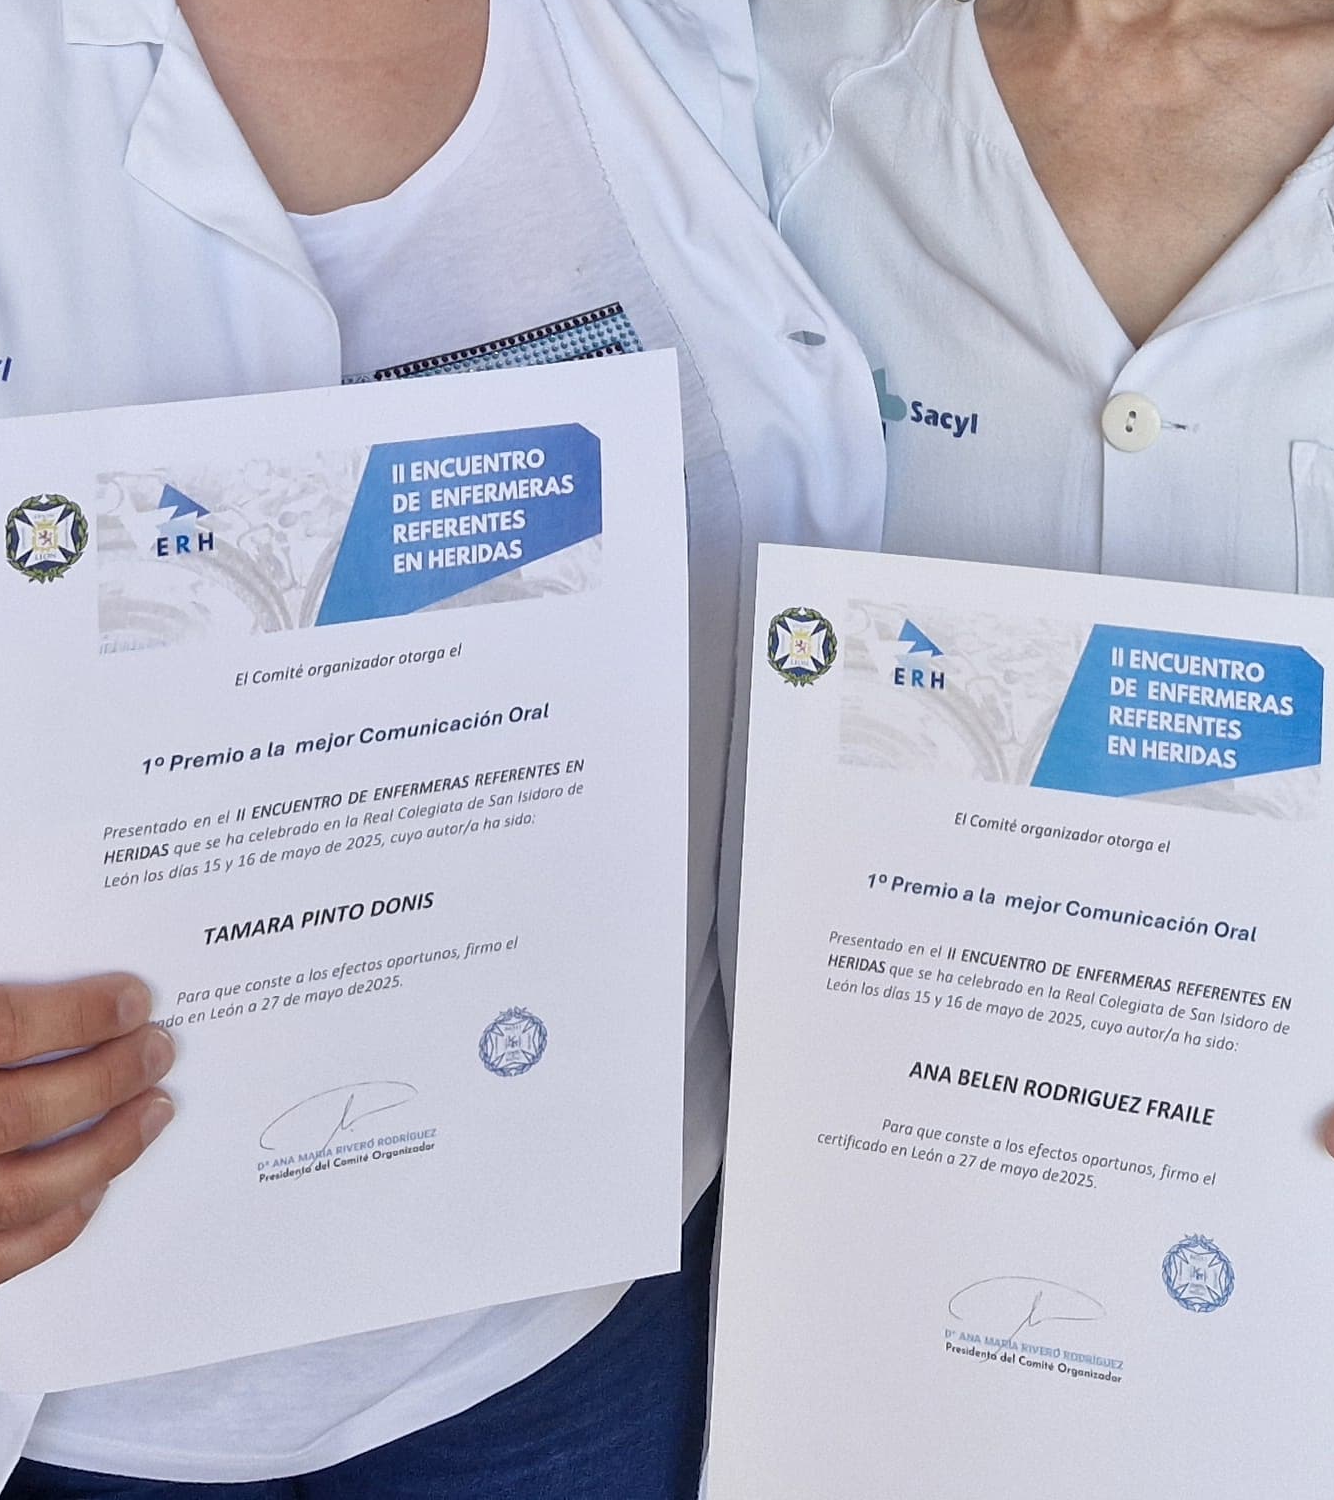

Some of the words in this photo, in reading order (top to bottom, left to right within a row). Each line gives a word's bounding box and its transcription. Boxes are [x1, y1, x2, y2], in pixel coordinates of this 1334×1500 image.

[910, 400, 979, 438] Sacyl
[391, 462, 405, 485] II
[410, 448, 546, 483] ENCUENTRO
[392, 492, 421, 514] DE
[431, 475, 575, 511] ENFERMERAS
[392, 509, 526, 544] REFERENTES
[393, 552, 424, 574] EN
[428, 539, 523, 570] HERIDAS
[234, 671, 249, 686] El
[252, 664, 304, 684] Comité
[307, 654, 396, 678] organizador
[398, 649, 446, 664] otorga
[449, 642, 463, 657] el
[1111, 647, 1124, 667] II
[1129, 649, 1266, 683] ENCUENTRO
[1110, 676, 1138, 698] DE
[1147, 681, 1294, 716] ENFERMERAS
[169, 747, 245, 771] Premio
[249, 748, 262, 760] a
[266, 742, 286, 757] la
[295, 733, 356, 754] mejor
[359, 710, 503, 743] Comunicación
[508, 702, 550, 722] Oral
[1108, 706, 1242, 740] REFERENTES
[1107, 735, 1137, 757] EN
[1141, 739, 1238, 769] HERIDAS
[103, 818, 188, 840] Presentado
[193, 817, 211, 828] en
[217, 810, 231, 824] el
[235, 808, 246, 821] II
[251, 794, 343, 819] ENCUENTRO
[347, 790, 369, 804] DE
[373, 775, 470, 801] ENFERMERAS
[474, 762, 561, 787] REFERENTES
[565, 759, 585, 773] EN
[103, 843, 170, 865] HERIDAS
[173, 842, 202, 858] que
[204, 838, 221, 849] se
[225, 833, 245, 846] ha
[248, 821, 320, 842] celebrado
[323, 820, 341, 831] en
[345, 815, 359, 828] la
[362, 808, 395, 825] Real
[397, 801, 464, 819] Colegiata
[467, 796, 485, 810] de
[487, 794, 514, 807] San
[517, 788, 564, 803] Isidoro
[567, 782, 584, 795] de
[954, 812, 968, 825] El
[969, 814, 1018, 832] Comité
[1020, 824, 1105, 844] organizador
[1106, 835, 1155, 852] otorga
[1157, 840, 1171, 853] el
[103, 872, 140, 888] León
[142, 870, 164, 883] los
[168, 864, 199, 880] días
[203, 859, 221, 873] 15
[224, 860, 234, 873] y
[237, 853, 257, 867] 16
[259, 850, 278, 863] de
[280, 846, 321, 861] mayo
[324, 840, 343, 853] de
[345, 833, 385, 850] 2025,
[390, 830, 423, 844] cuyo
[426, 818, 480, 838] autor/a
[482, 817, 501, 830] ha
[503, 812, 536, 827] sido:
[203, 914, 295, 945] TAMARA
[301, 903, 365, 928] PINTO
[370, 892, 435, 917] DONIS
[890, 876, 959, 899] Premio
[962, 890, 974, 901] a
[978, 887, 996, 904] la
[1004, 896, 1063, 915] mejor
[1065, 901, 1209, 935] Comunicación
[1214, 922, 1257, 942] Oral
[908, 1062, 952, 1083] ANA
[957, 1069, 1019, 1093] BELEN
[1023, 1079, 1143, 1113] RODRIGUEZ
[1145, 1099, 1216, 1125] FRAILE
[259, 1165, 311, 1183] Presidenta
[315, 1160, 330, 1172] del
[333, 1155, 368, 1167] Comité
[372, 1142, 435, 1160] Organizador
[817, 1134, 888, 1153] certificado
[890, 1146, 908, 1156] en
[910, 1146, 944, 1163] León
[946, 1155, 956, 1165] a
[958, 1154, 978, 1167] 27
[979, 1157, 997, 1171] de
[999, 1164, 1039, 1180] mayo
[881, 1119, 914, 1135] Para
[916, 1128, 943, 1140] que
[944, 1132, 990, 1148] conste
[992, 1140, 1002, 1150] a
[1004, 1138, 1025, 1156] los
[1027, 1143, 1078, 1162] efectos
[1081, 1155, 1156, 1178] oportunos,
[1158, 1164, 1200, 1183] firmo
[1202, 1172, 1217, 1186] el
